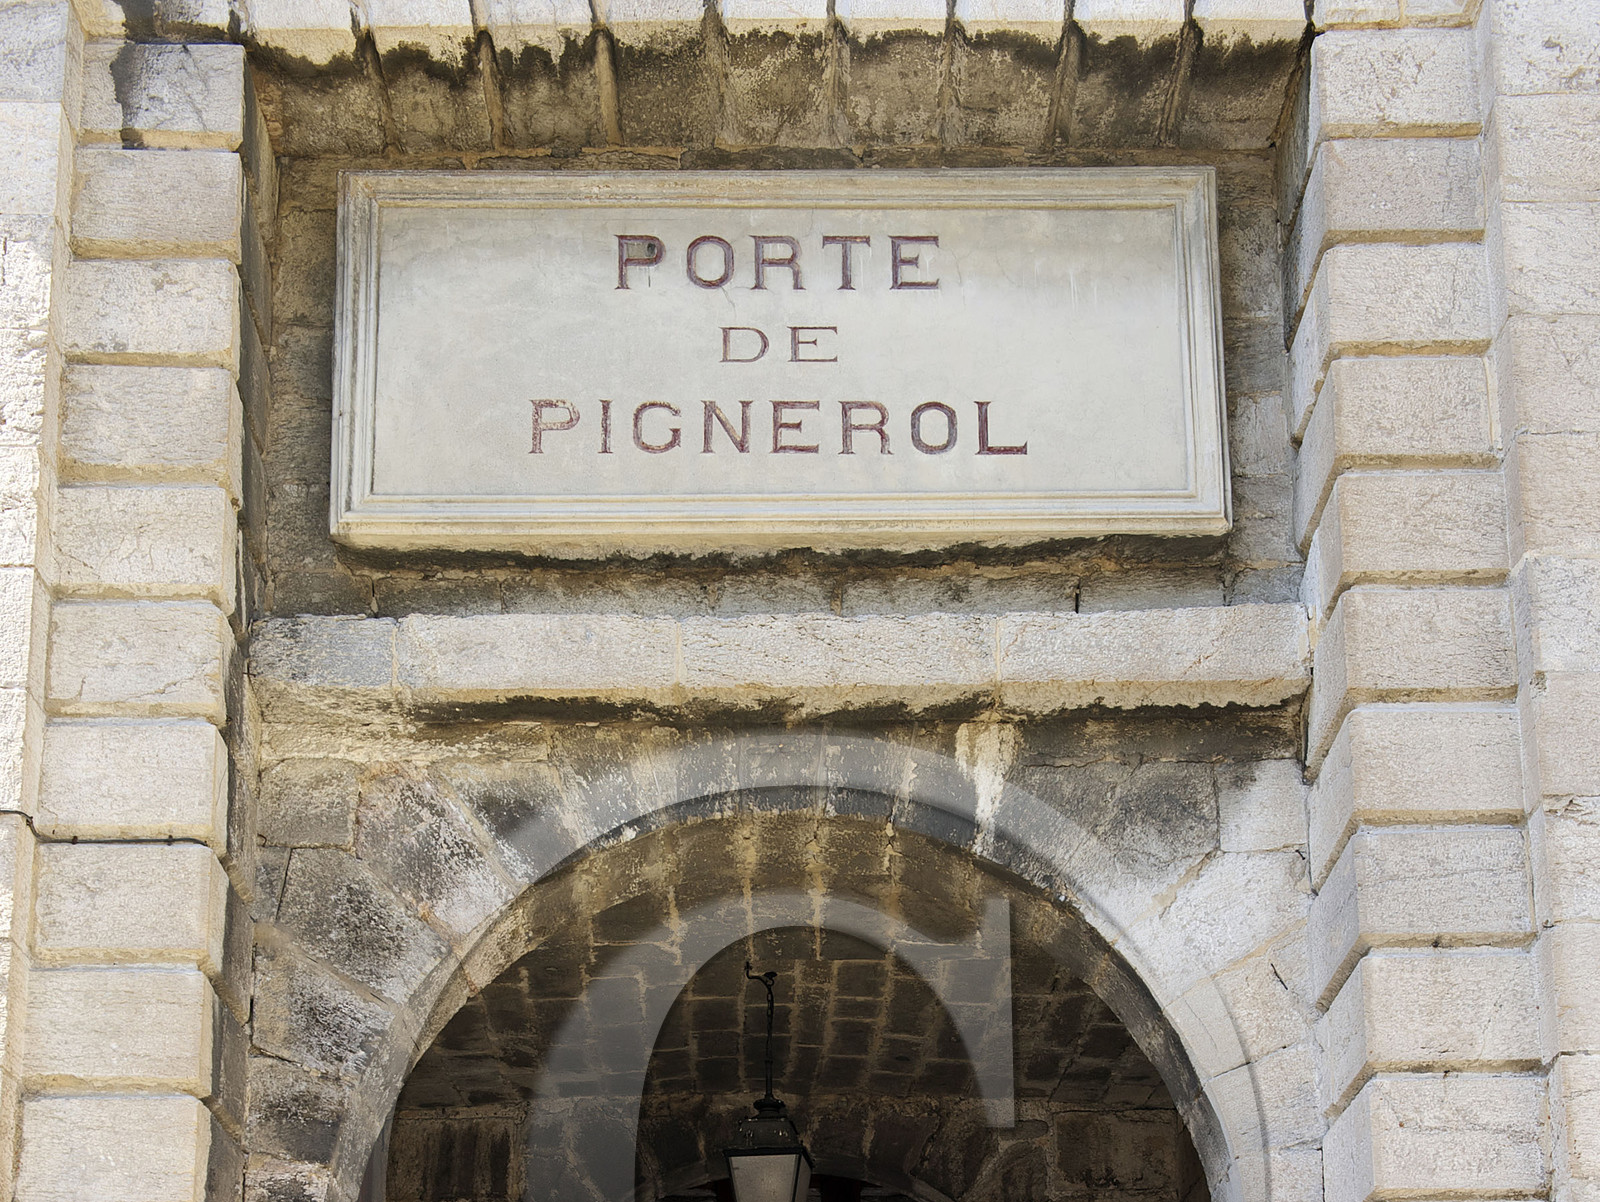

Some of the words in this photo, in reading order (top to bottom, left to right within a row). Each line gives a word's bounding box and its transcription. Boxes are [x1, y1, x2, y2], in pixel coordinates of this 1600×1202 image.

[614, 234, 940, 290] PORTE
[719, 326, 838, 363] DE
[528, 399, 1028, 456] PIGNEROL
